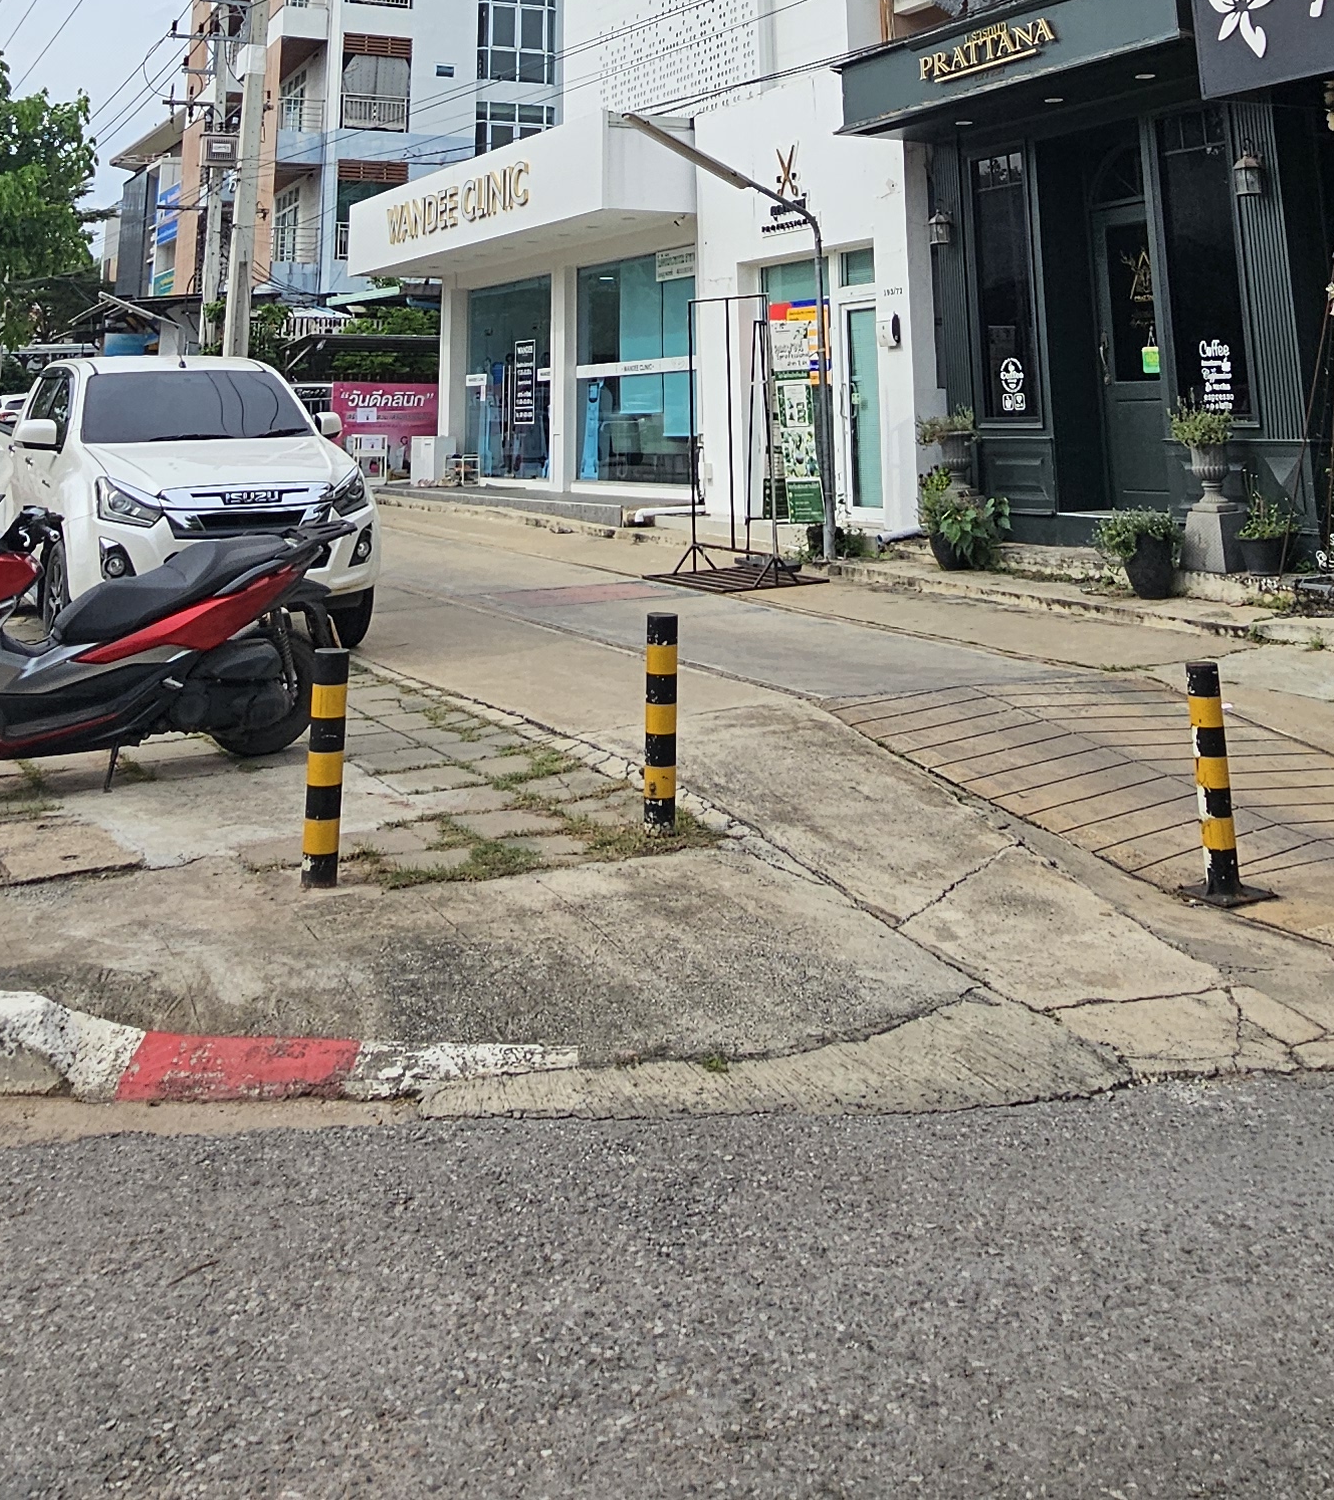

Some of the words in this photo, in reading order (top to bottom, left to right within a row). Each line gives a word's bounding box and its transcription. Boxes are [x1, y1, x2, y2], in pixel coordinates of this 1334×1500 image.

[918, 17, 1056, 81] PRATTANA
[386, 185, 459, 245] WANDEE
[460, 160, 530, 223] CLINIC
[1199, 339, 1230, 357] Coffee
[225, 490, 279, 503] ISUZU
